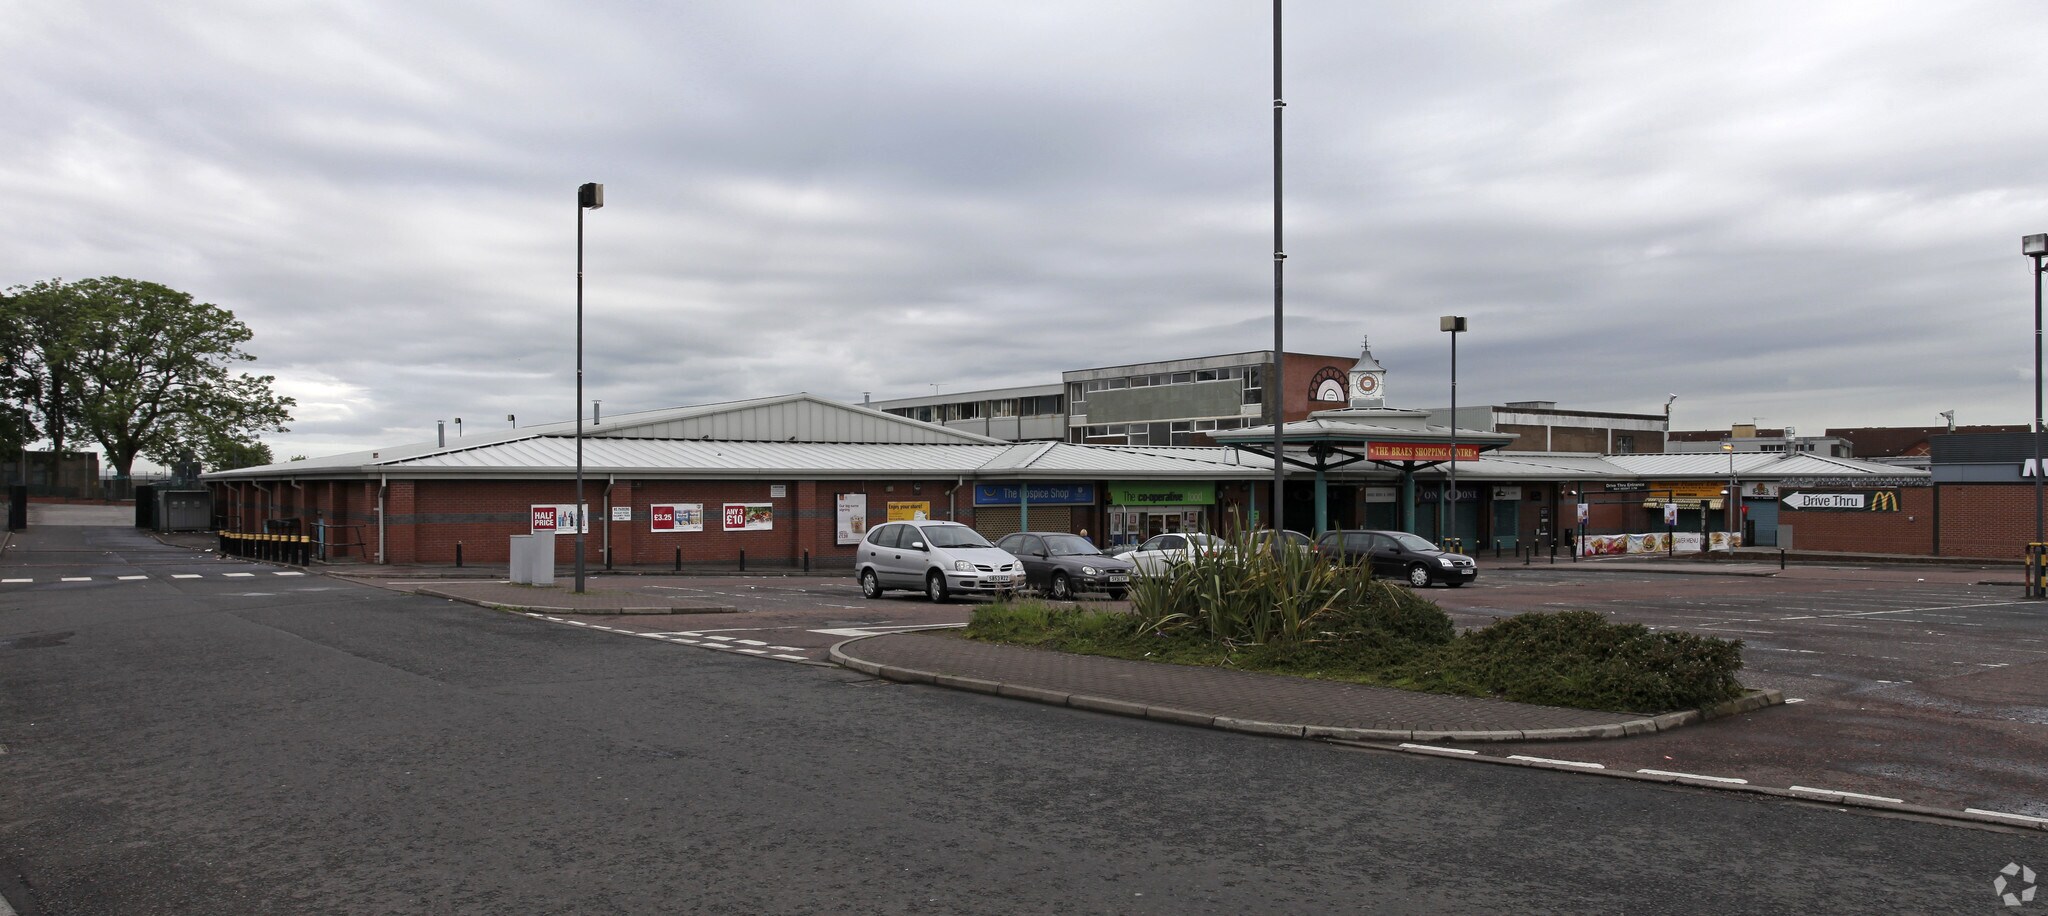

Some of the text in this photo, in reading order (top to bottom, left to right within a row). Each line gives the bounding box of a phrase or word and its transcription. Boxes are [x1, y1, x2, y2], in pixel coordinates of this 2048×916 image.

[1375, 446, 1473, 457] THE BRAES SHOPPING CNTRE
[1003, 488, 1017, 499] The
[1050, 488, 1069, 500] Shop
[1124, 491, 1202, 503] The co-operative food
[1424, 490, 1439, 499] ON
[1462, 490, 1477, 499] ONE
[1803, 495, 1858, 506] Drive Thru
[534, 511, 554, 519] HALF
[654, 513, 672, 521] £3.25
[726, 515, 743, 525] £10
